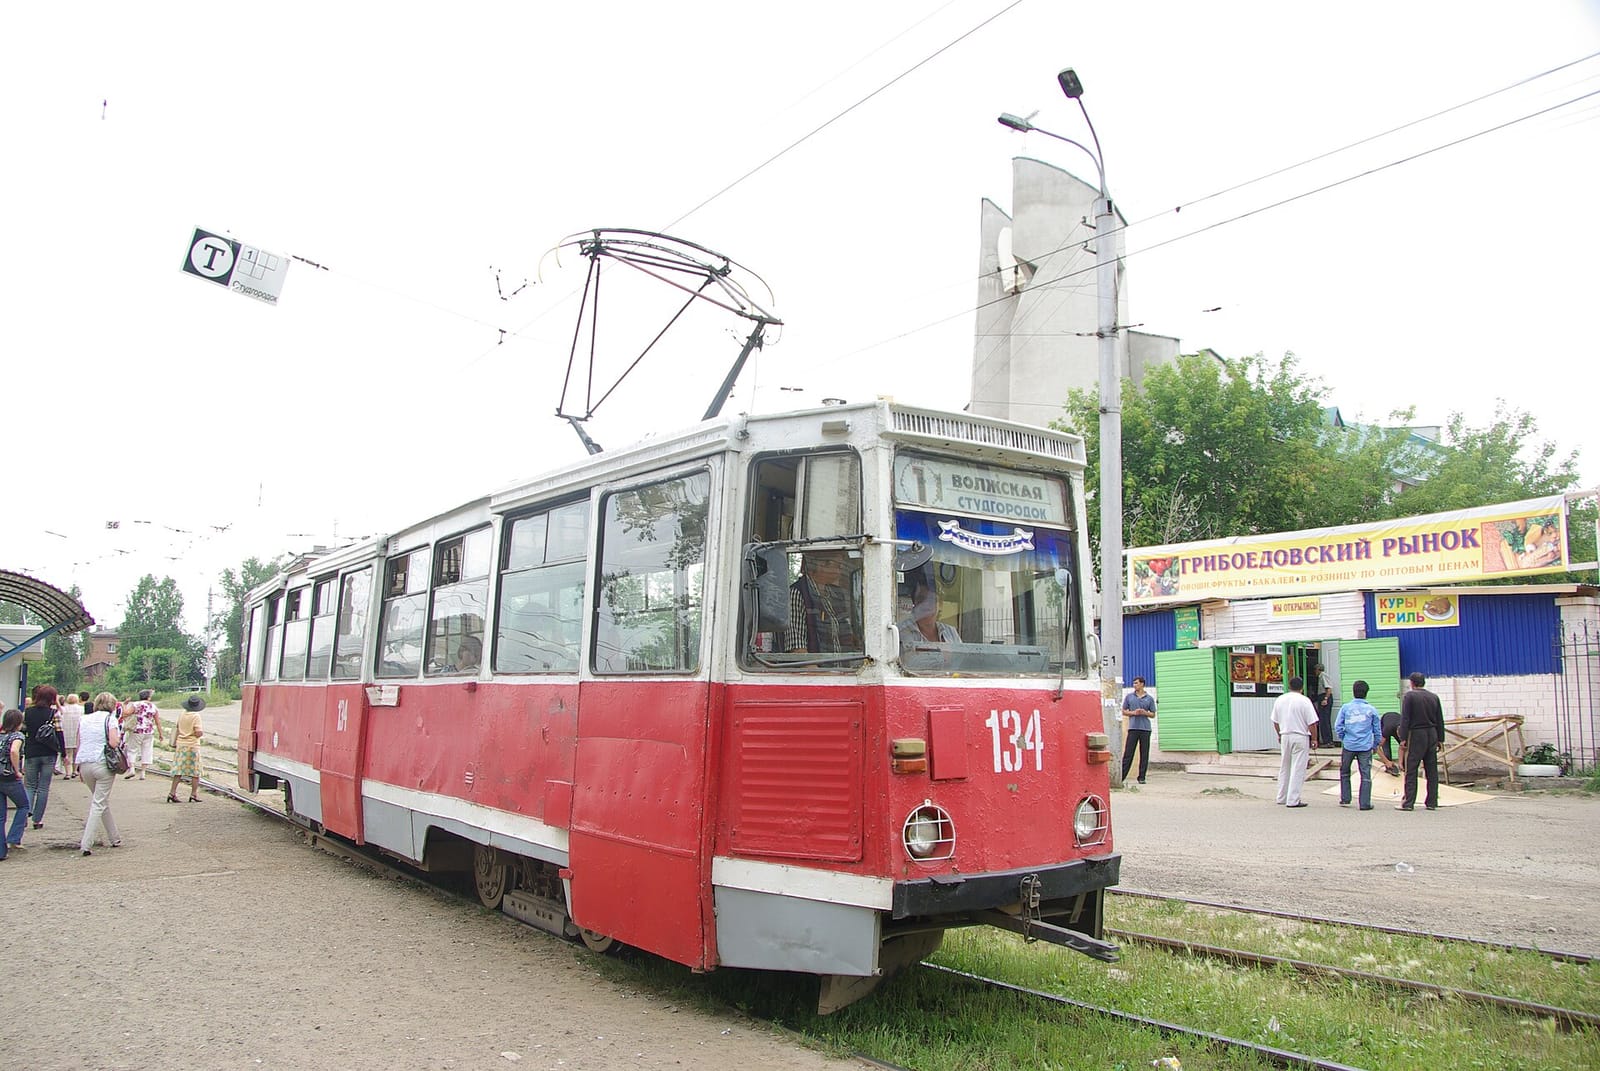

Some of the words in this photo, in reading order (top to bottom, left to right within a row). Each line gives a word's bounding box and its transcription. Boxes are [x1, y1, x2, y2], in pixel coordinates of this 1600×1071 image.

[247, 250, 254, 260] 1
[232, 280, 278, 302] Студгородок
[952, 473, 1043, 500] ВОЛЖСКАЯ
[957, 495, 1048, 520] СТУДГОРОДОК
[1180, 537, 1372, 575] ГРИБОЕДОВСКИЙ
[1381, 527, 1481, 558] РЫНОК
[1311, 571, 1357, 583] РОЗНИЦУ
[1361, 569, 1375, 579] ПО
[1380, 564, 1434, 577] ОПТОВЫМ
[1438, 560, 1480, 573] ЦЕНАМ
[1380, 597, 1417, 609] КУРЫ
[1380, 612, 1425, 623] ГРИЛЬ
[985, 708, 1044, 773] 134
